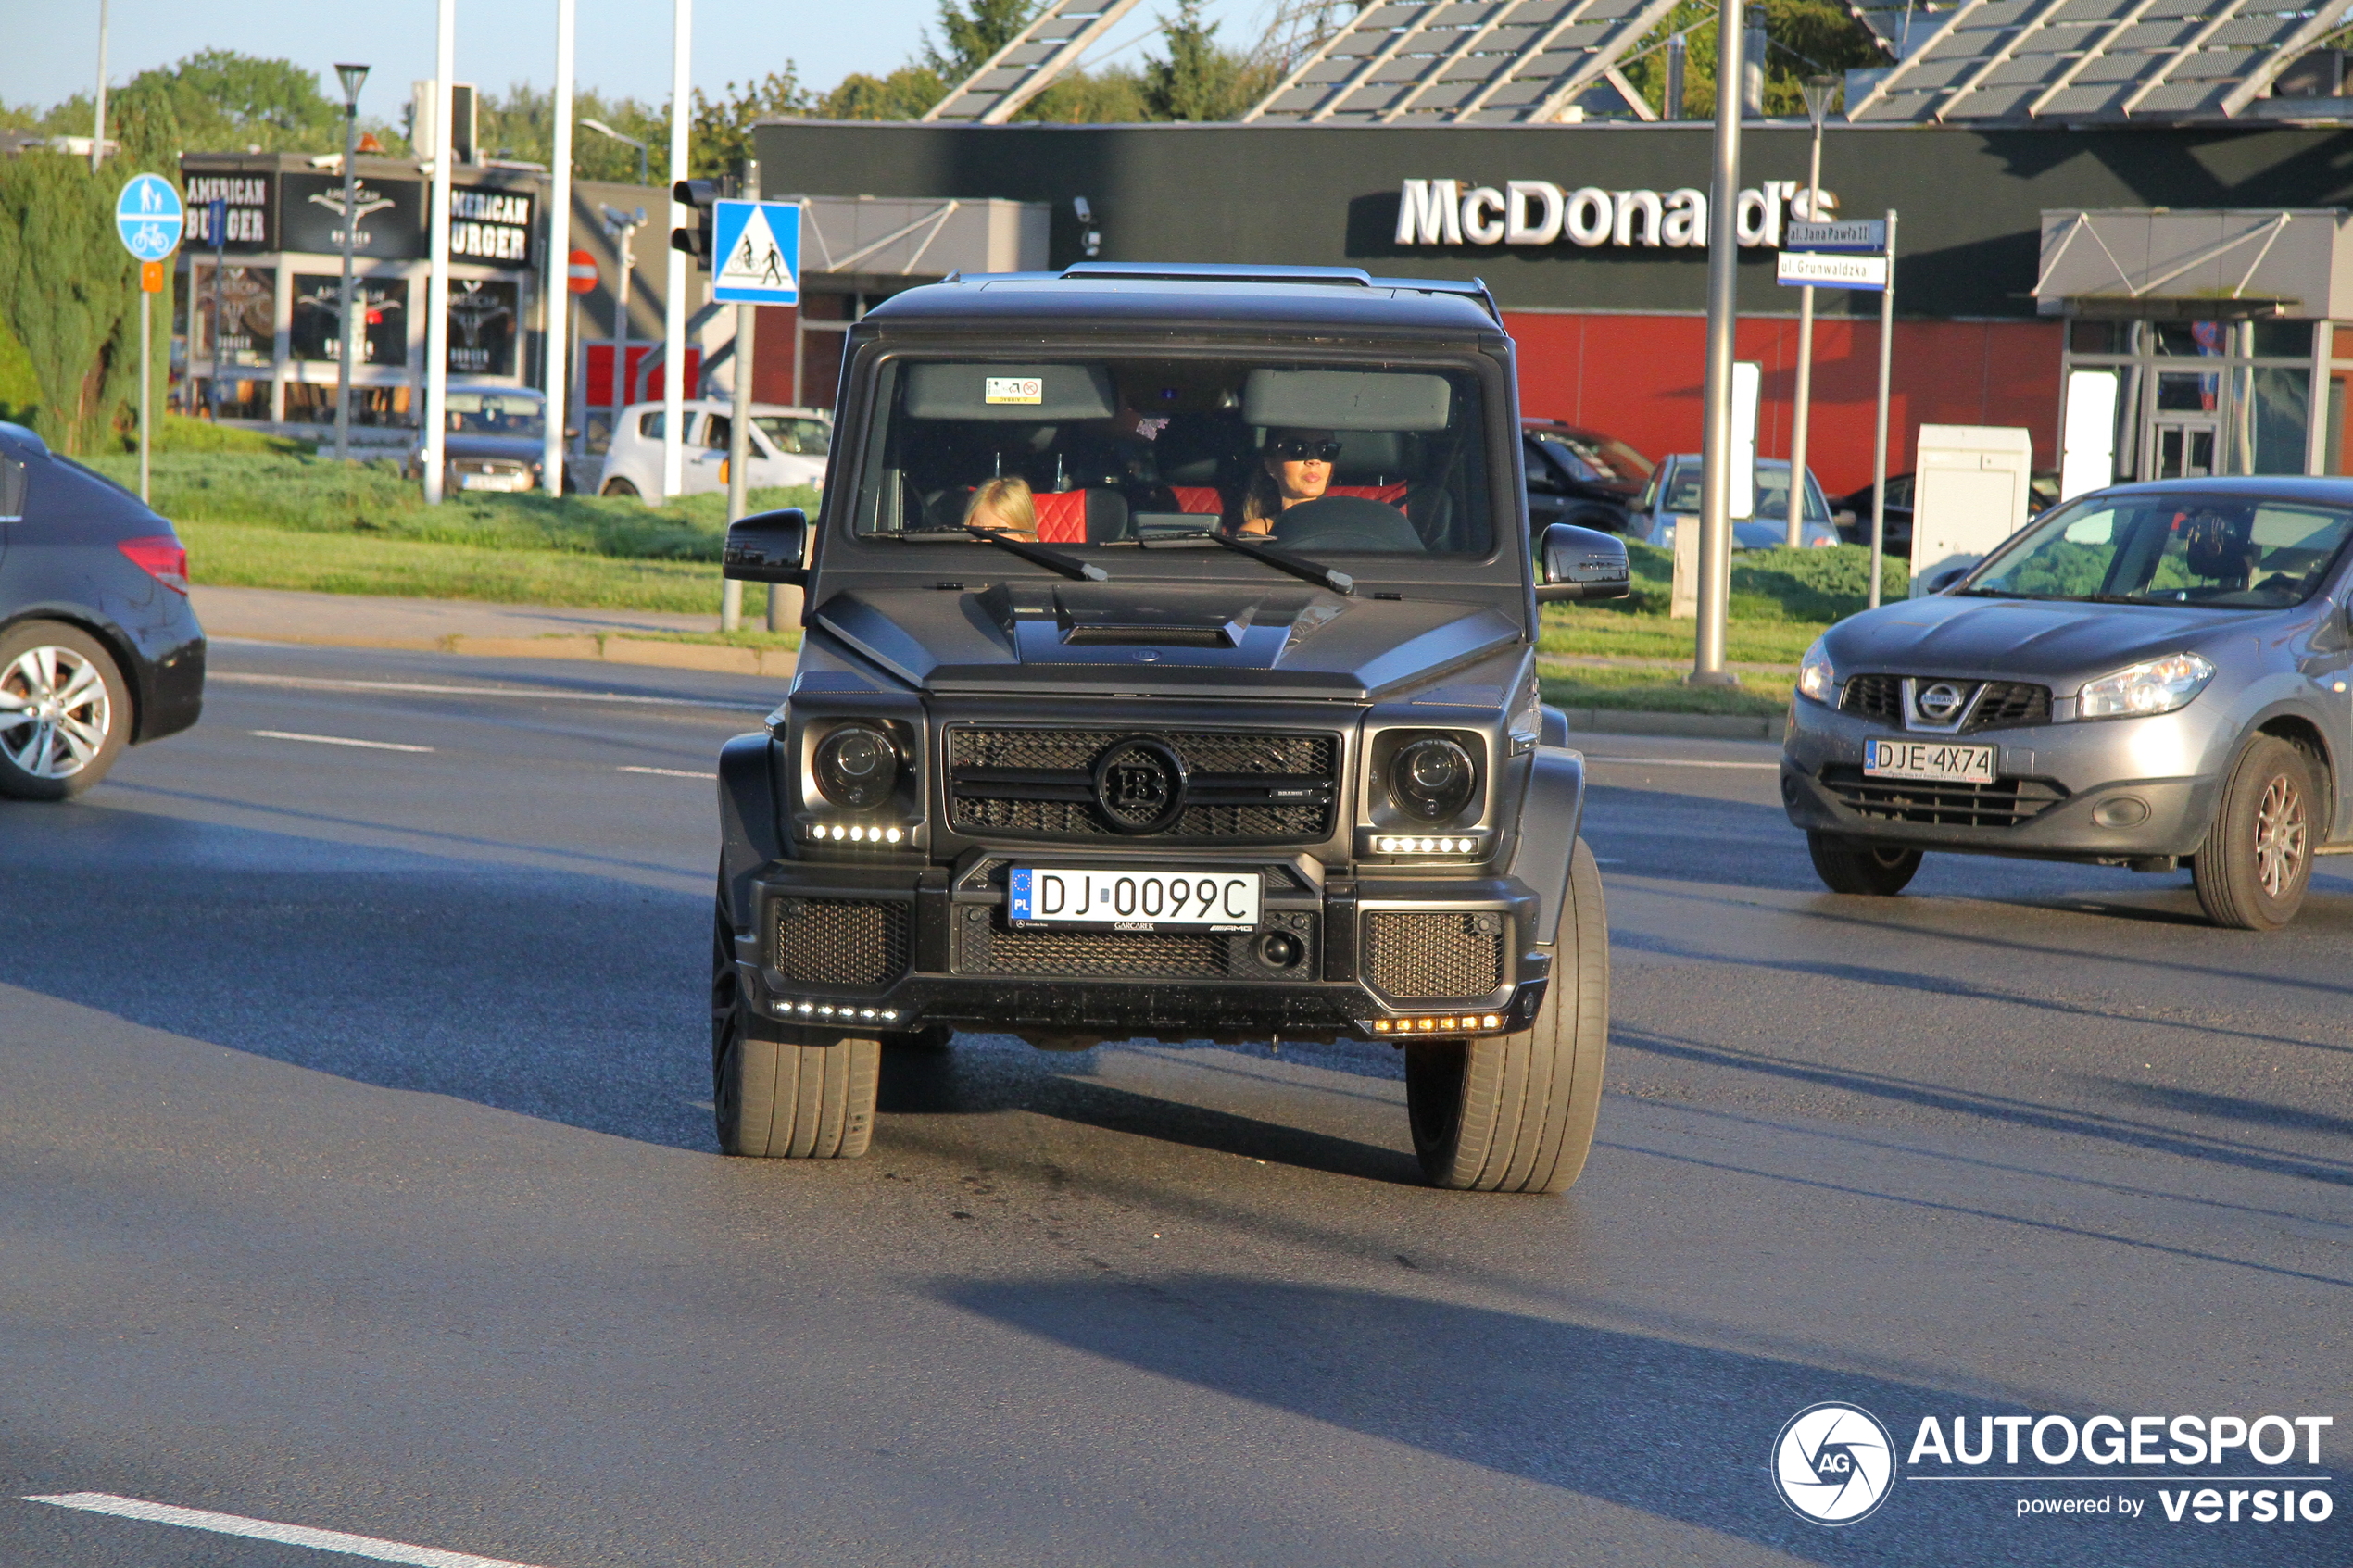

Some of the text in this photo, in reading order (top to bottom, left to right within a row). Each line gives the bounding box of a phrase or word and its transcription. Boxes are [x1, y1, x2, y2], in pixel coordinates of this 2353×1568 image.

[187, 177, 265, 205] AMERICAN
[451, 190, 530, 226] MERICAN
[1395, 179, 1834, 248] McDonad's
[186, 207, 265, 242] BUGER
[331, 230, 371, 244] BUGER
[1790, 226, 1869, 242] al. Jana Pawła II
[451, 221, 526, 260] URGER
[1781, 258, 1867, 278] ul. Grunwaldzka
[1879, 744, 1990, 774] DJE 4X74
[1014, 899, 1029, 910] PL
[1041, 875, 1247, 919] DJ 0099C
